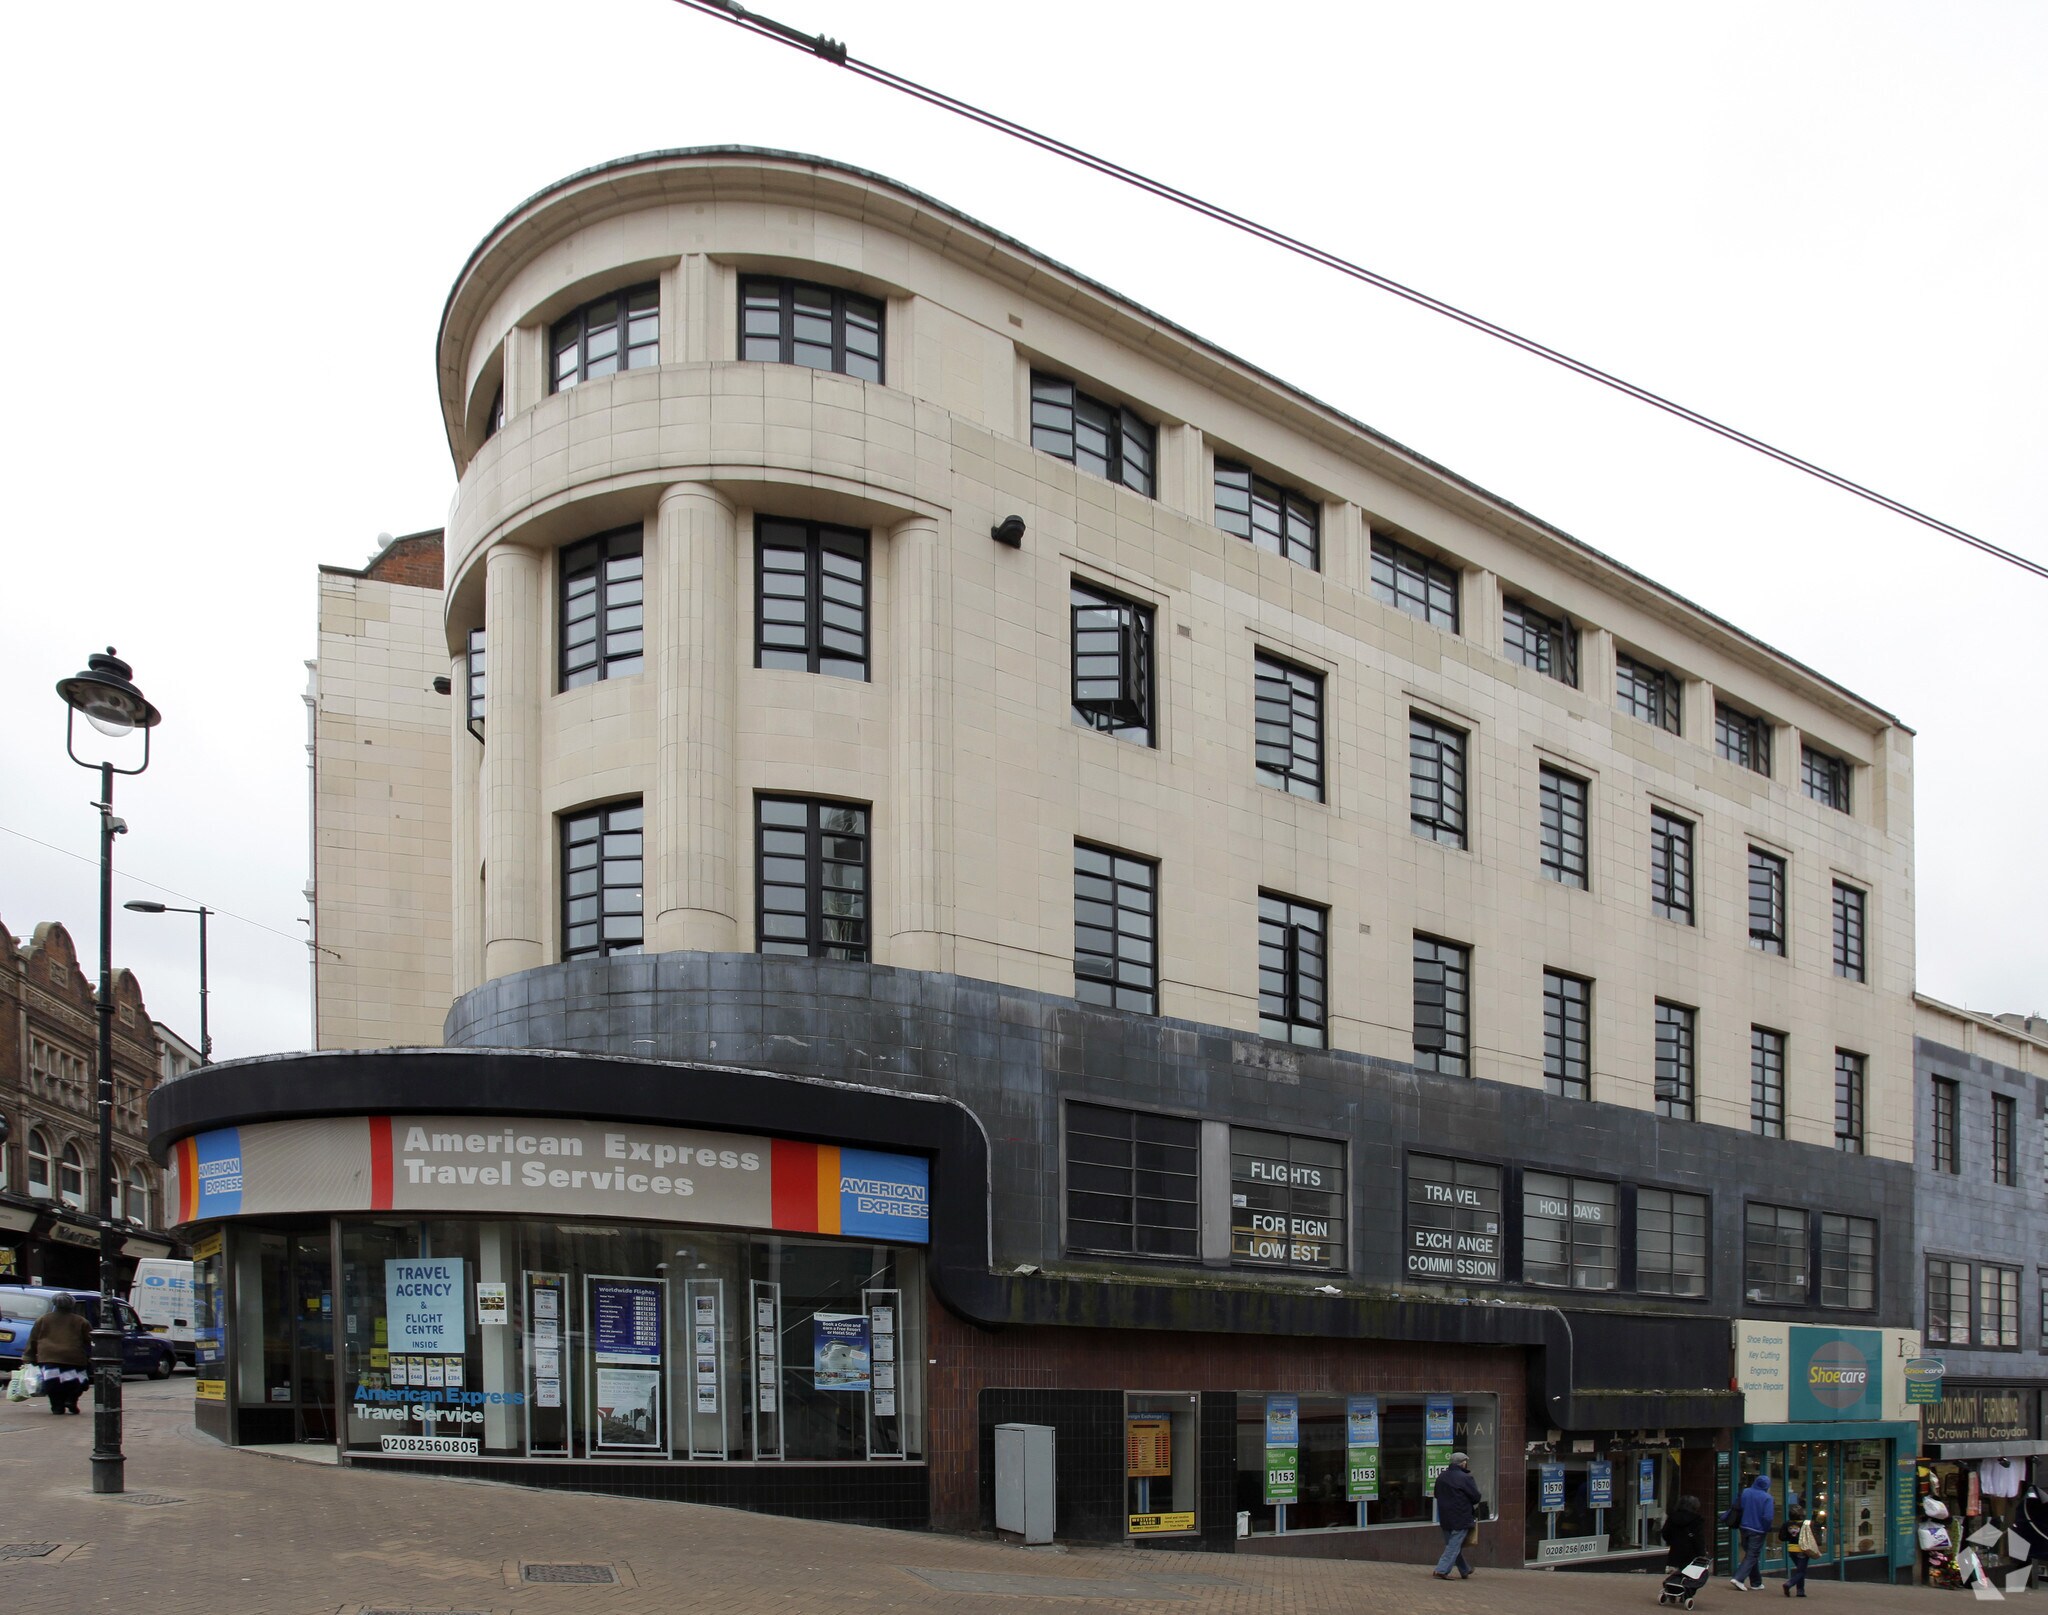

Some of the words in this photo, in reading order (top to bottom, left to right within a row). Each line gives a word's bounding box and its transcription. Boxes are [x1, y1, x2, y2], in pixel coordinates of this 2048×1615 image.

[404, 1127, 582, 1156] American
[605, 1133, 760, 1171] Express
[198, 1158, 240, 1179] AMERICAN
[404, 1159, 511, 1185] Travel
[521, 1161, 694, 1196] Services
[1251, 1162, 1321, 1186] FLIGHTS
[205, 1176, 243, 1195] EXPRESS
[840, 1177, 925, 1201] AMERICAN
[1424, 1185, 1481, 1206] TRAVEL
[858, 1197, 929, 1219] EXPRESS
[1540, 1200, 1601, 1220] HOLIDAYS
[1252, 1215, 1328, 1237] FOREIGN
[1416, 1231, 1493, 1253] EXCHANGE
[1249, 1241, 1321, 1262] LOWEST
[397, 1267, 450, 1280] TRAVEL
[1408, 1255, 1496, 1276] COMMISSION
[396, 1283, 452, 1297] AGENCY
[421, 1301, 427, 1309] &
[406, 1314, 443, 1323] FLIGHT
[405, 1325, 444, 1335] CENTRE
[412, 1341, 438, 1349] INSIDE
[1746, 1335, 1760, 1344] Shoe
[1762, 1336, 1783, 1345] Repairs
[1748, 1351, 1759, 1360] Key
[1760, 1351, 1780, 1361] Cutting
[1750, 1367, 1779, 1376] Engraving
[1810, 1366, 1866, 1383] Shoecare
[1904, 1367, 1943, 1375] Shoecare
[354, 1385, 444, 1402] American
[446, 1387, 525, 1405] Express
[1743, 1382, 1762, 1391] Watch
[1763, 1382, 1784, 1391] Repairs
[354, 1403, 408, 1421] Travel
[412, 1404, 484, 1423] Service
[1972, 1427, 1987, 1438] Hill
[1990, 1427, 2028, 1439] Croydon
[382, 1438, 477, 1453] 02082560805
[1546, 1546, 1563, 1555] 0208
[1565, 1545, 1578, 1554] 256
[1580, 1543, 1596, 1552] 0801
